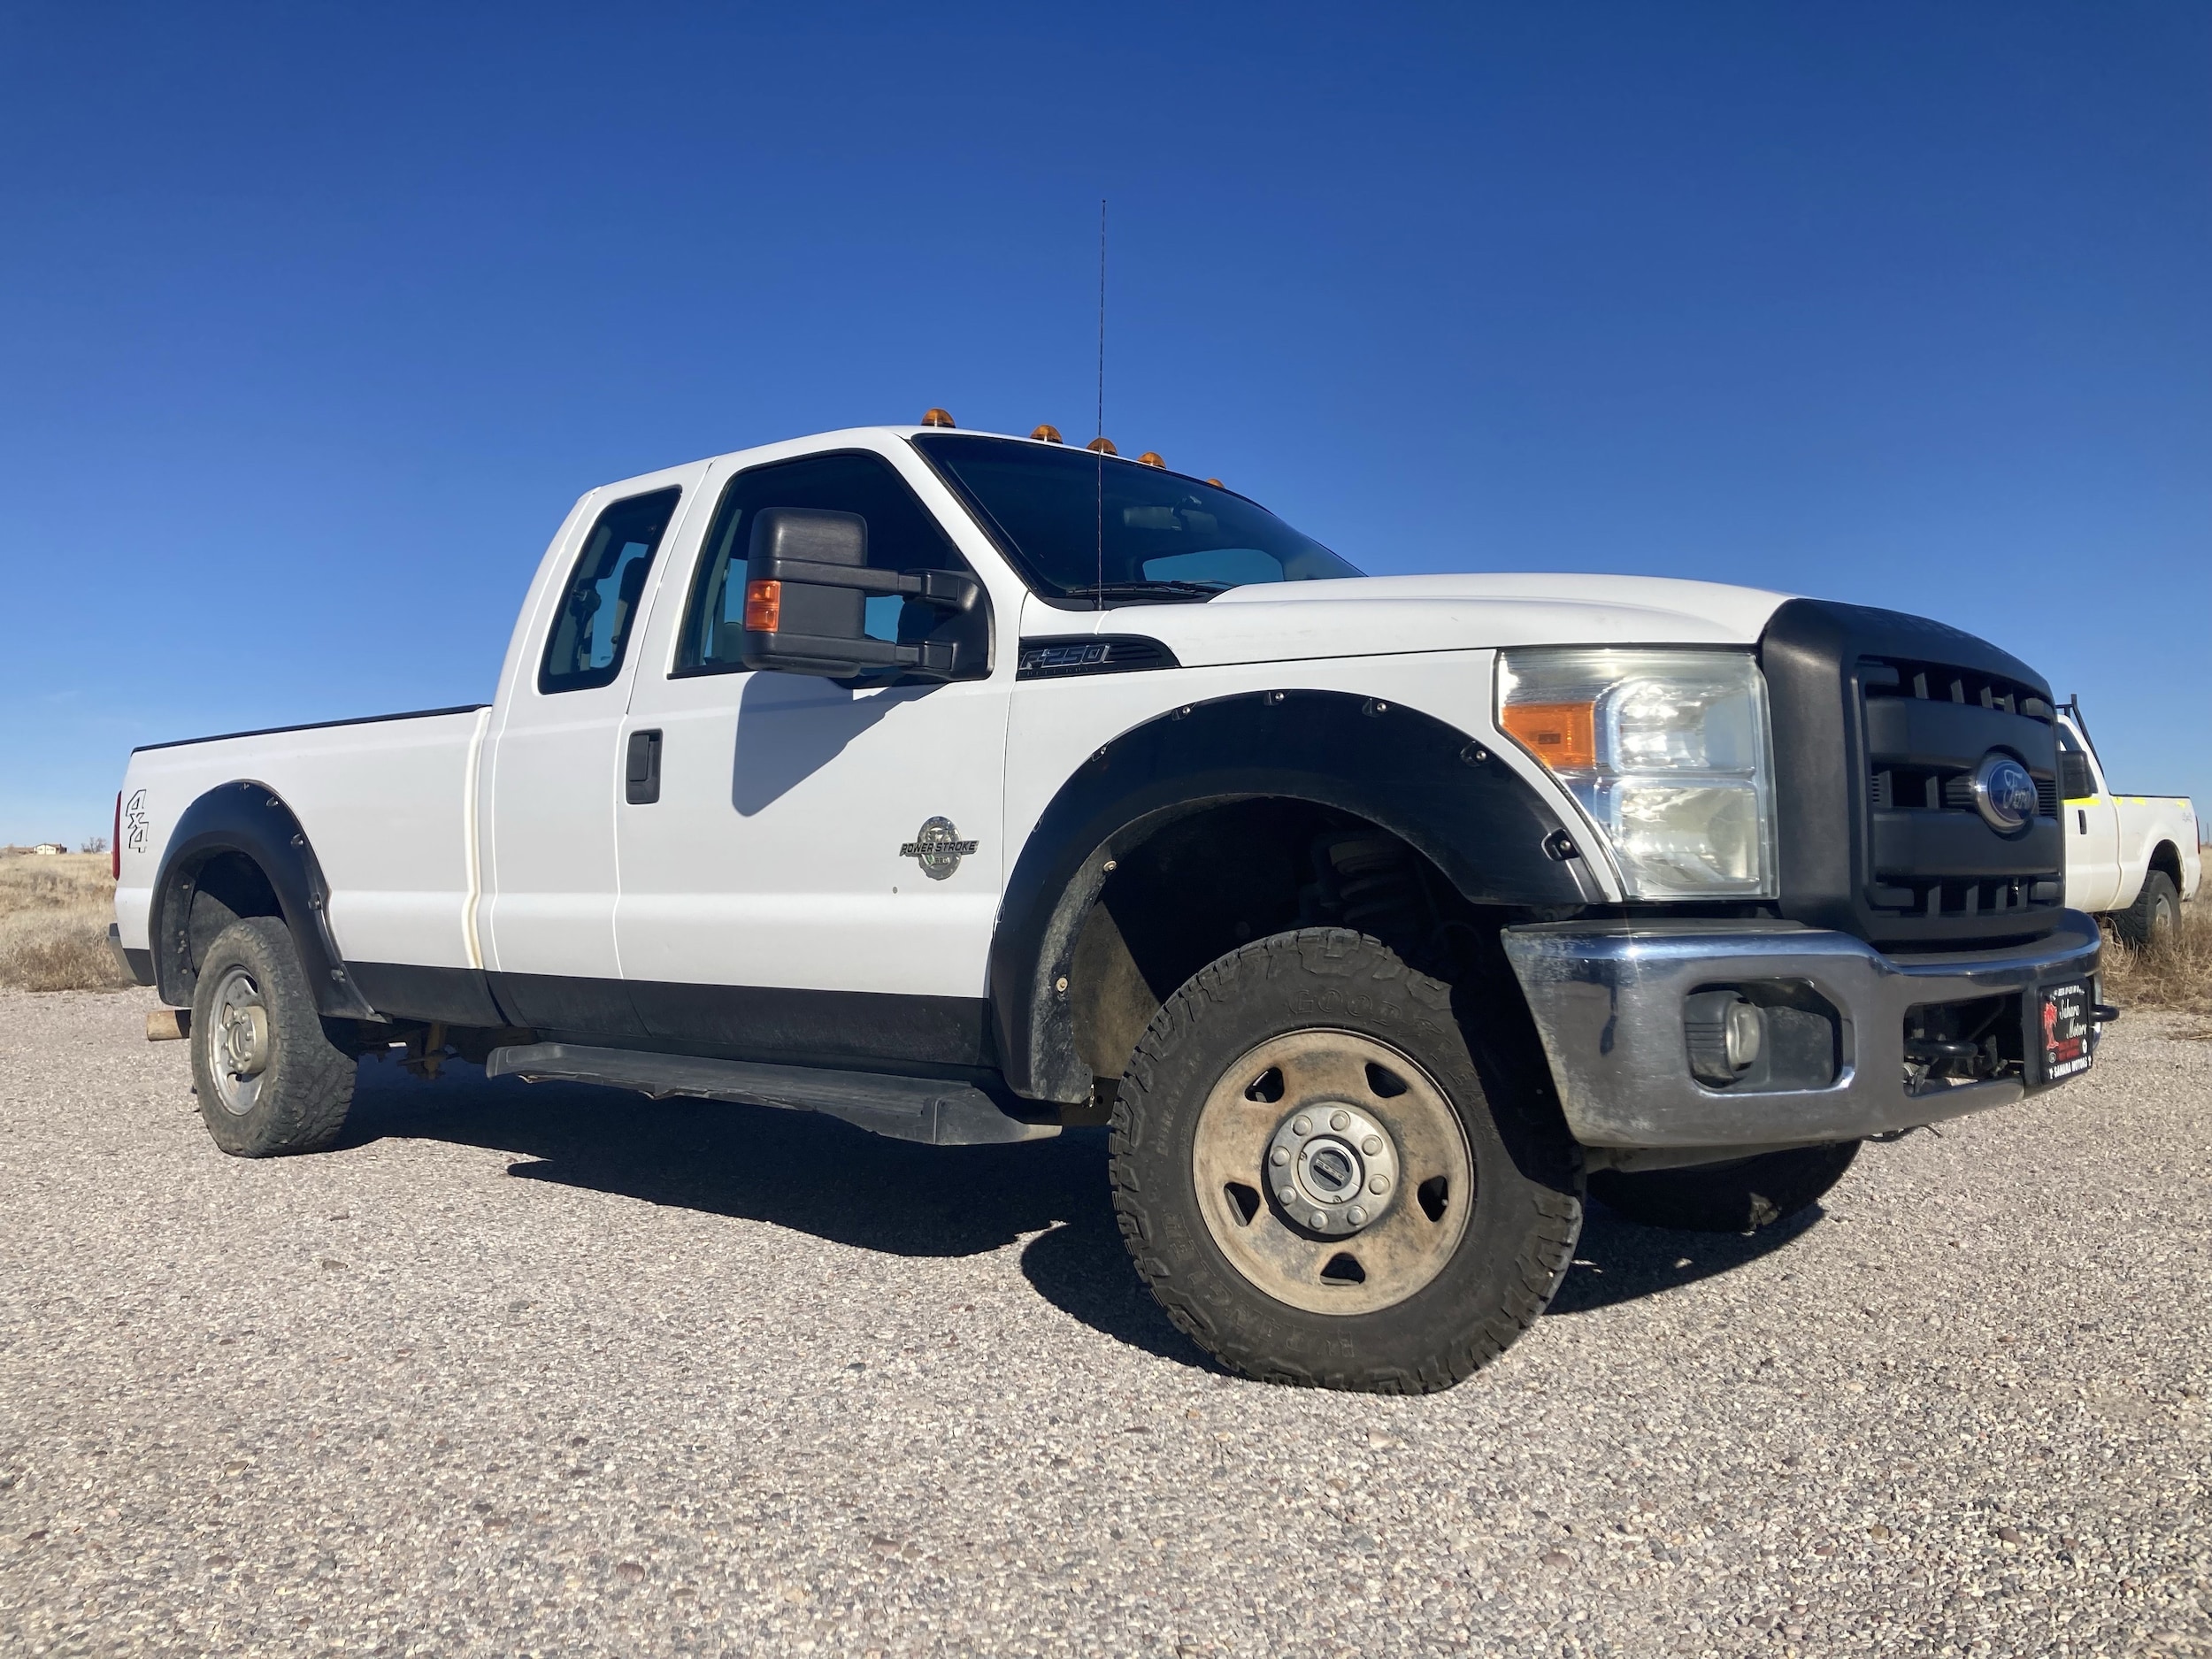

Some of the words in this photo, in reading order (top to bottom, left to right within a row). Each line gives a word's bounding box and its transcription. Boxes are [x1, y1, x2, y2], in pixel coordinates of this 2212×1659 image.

[899, 842, 934, 856] POWER
[935, 841, 979, 852] STROKE
[2054, 1062, 2071, 1078] SAHARA
[2071, 1056, 2088, 1072] MOTORS
[1316, 1158, 1346, 1180] FORD
